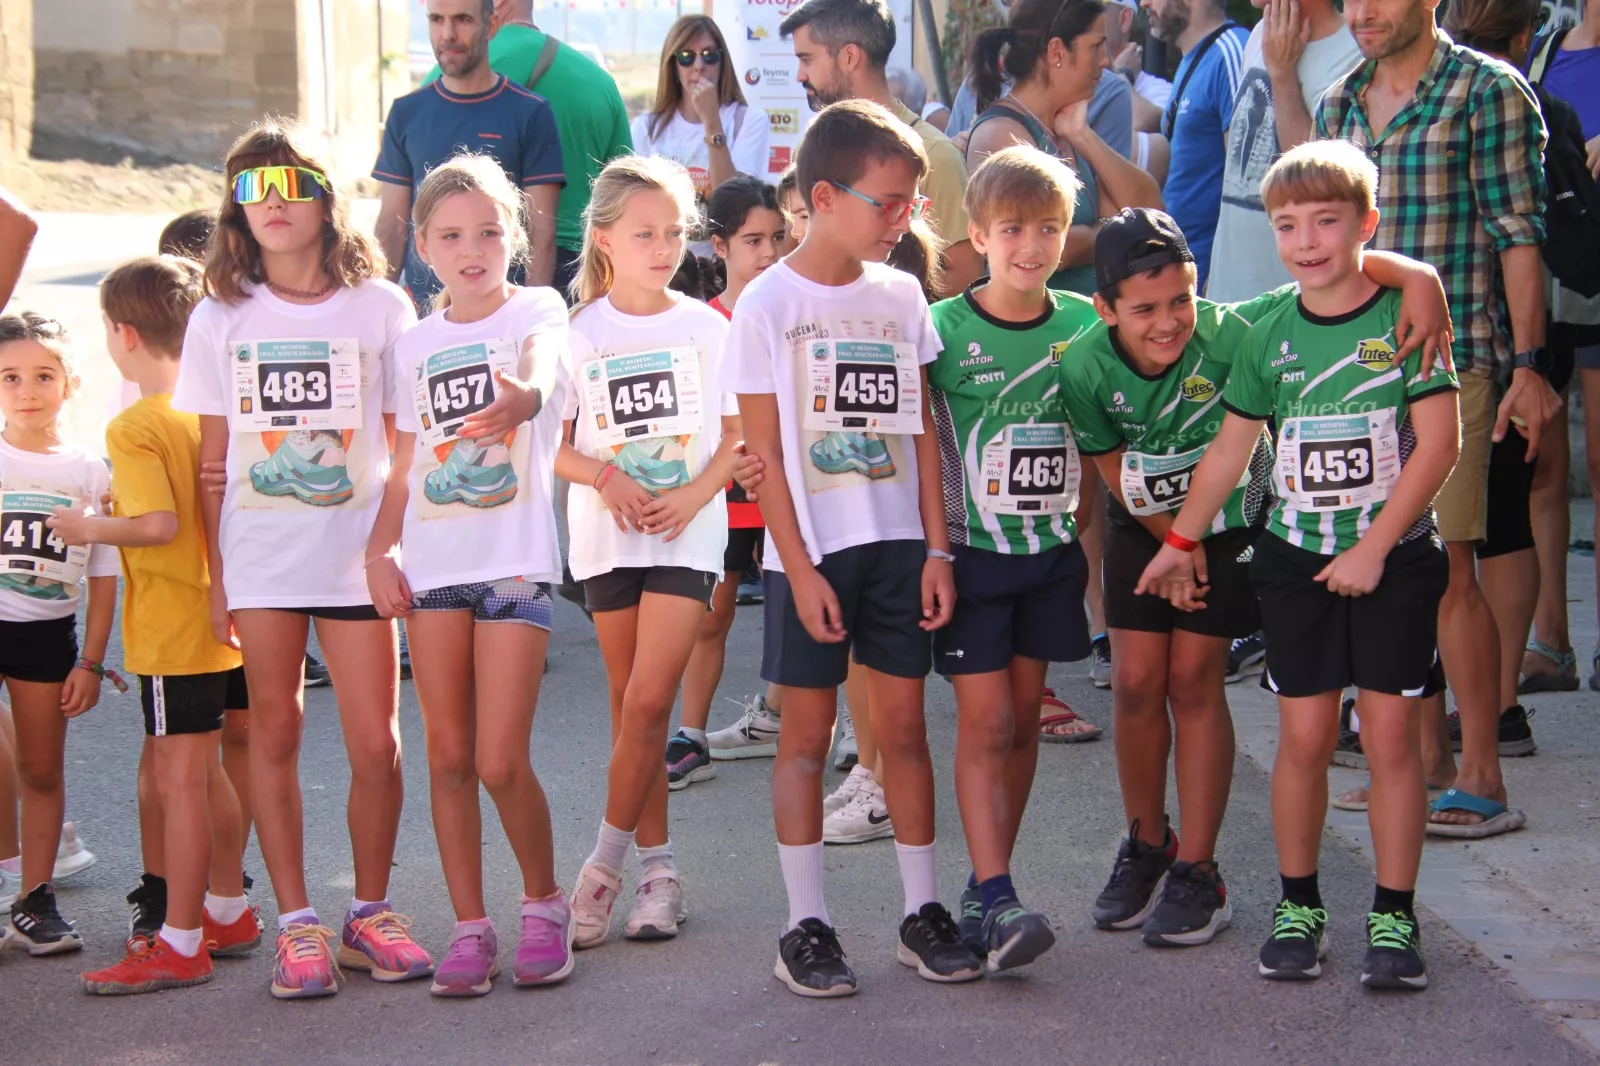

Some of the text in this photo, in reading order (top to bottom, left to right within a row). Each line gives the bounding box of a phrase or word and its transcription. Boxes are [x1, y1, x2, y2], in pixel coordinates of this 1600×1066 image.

[960, 356, 994, 367] VIATOR
[262, 371, 328, 402] 483
[433, 372, 488, 413] 457
[614, 379, 674, 415] 454
[838, 372, 896, 405] 455
[1012, 455, 1065, 488] 463
[1303, 447, 1369, 482] 453
[1153, 472, 1192, 496] 47
[3, 519, 65, 554] 414
